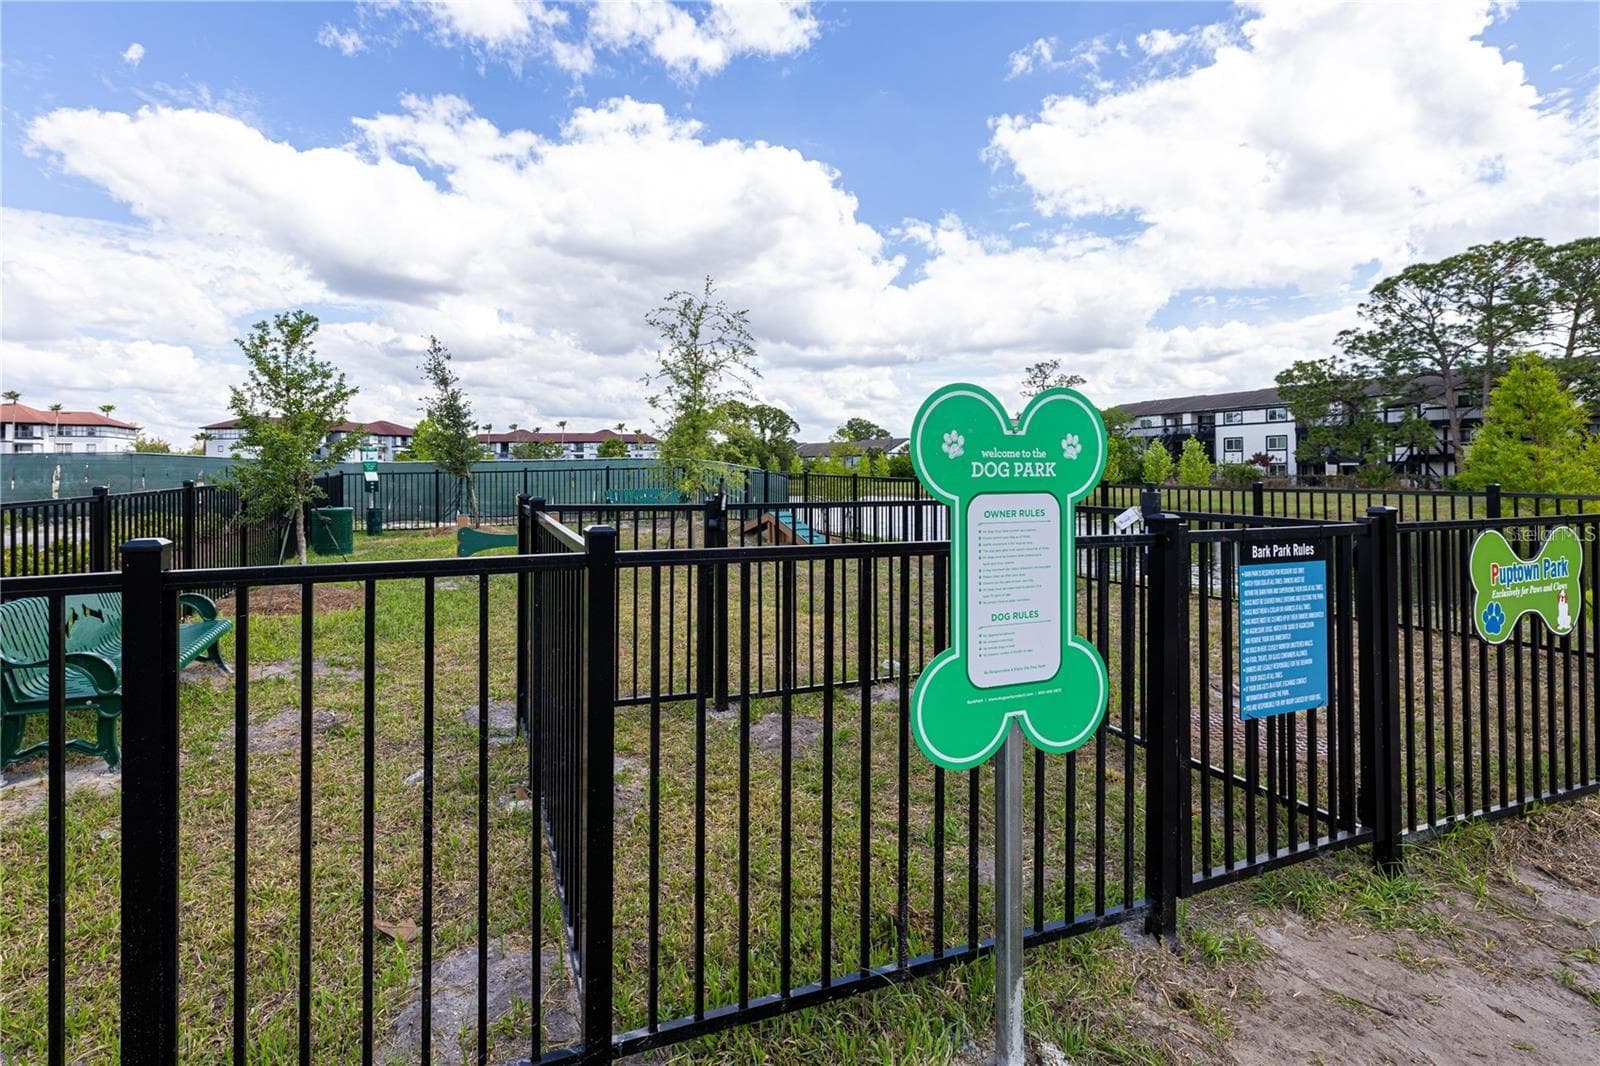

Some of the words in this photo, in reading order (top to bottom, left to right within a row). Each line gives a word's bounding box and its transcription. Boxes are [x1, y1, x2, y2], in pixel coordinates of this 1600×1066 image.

[981, 447, 1020, 458] welcome
[1021, 450, 1031, 458] to
[1032, 448, 1046, 458] the
[971, 461, 1010, 478] DOG
[1013, 462, 1056, 477] PARK
[984, 509, 1017, 519] OWNER
[1018, 508, 1046, 517] RULES
[1252, 545, 1271, 558] Bark
[1273, 544, 1291, 557] Park
[1293, 543, 1315, 556] Rules
[1490, 563, 1540, 588] Puptown
[1543, 556, 1569, 579] Park
[1491, 588, 1521, 599] Exclusively
[1520, 587, 1529, 598] for
[1543, 583, 1553, 592] and
[991, 612, 1010, 622] DOG
[1012, 609, 1039, 620] RULES
